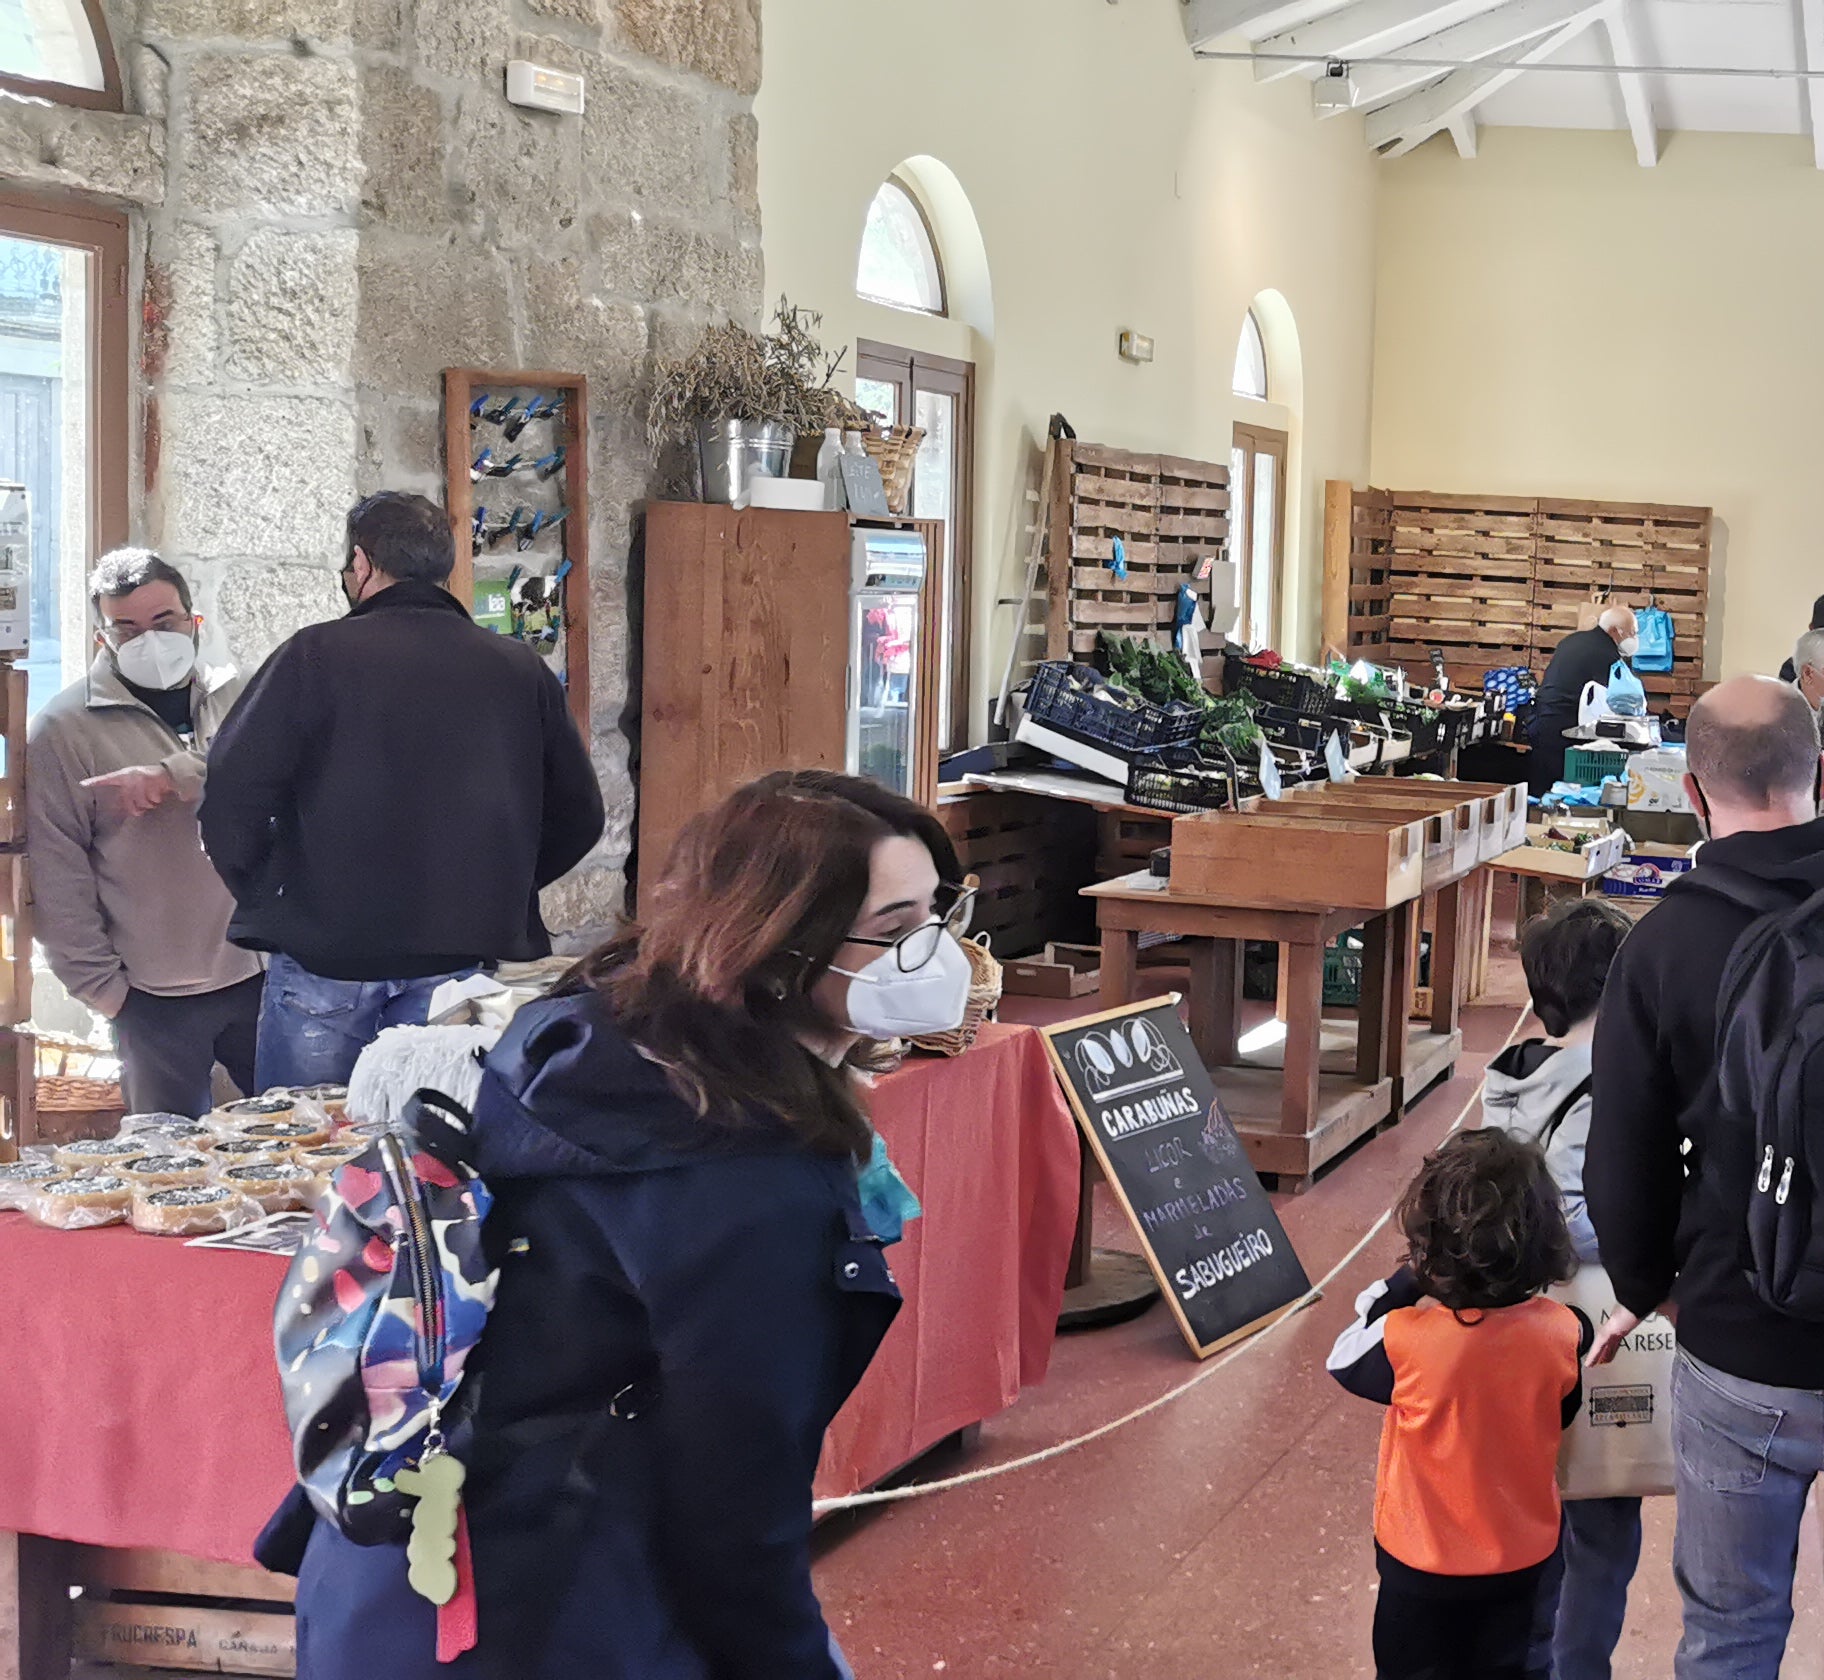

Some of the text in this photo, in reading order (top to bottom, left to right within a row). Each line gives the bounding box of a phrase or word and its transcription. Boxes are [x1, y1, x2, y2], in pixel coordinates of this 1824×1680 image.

[1101, 1087, 1199, 1138] CARABUÑAS
[1144, 1136, 1192, 1173] LICOR
[1142, 1177, 1248, 1232] MARMELADAS
